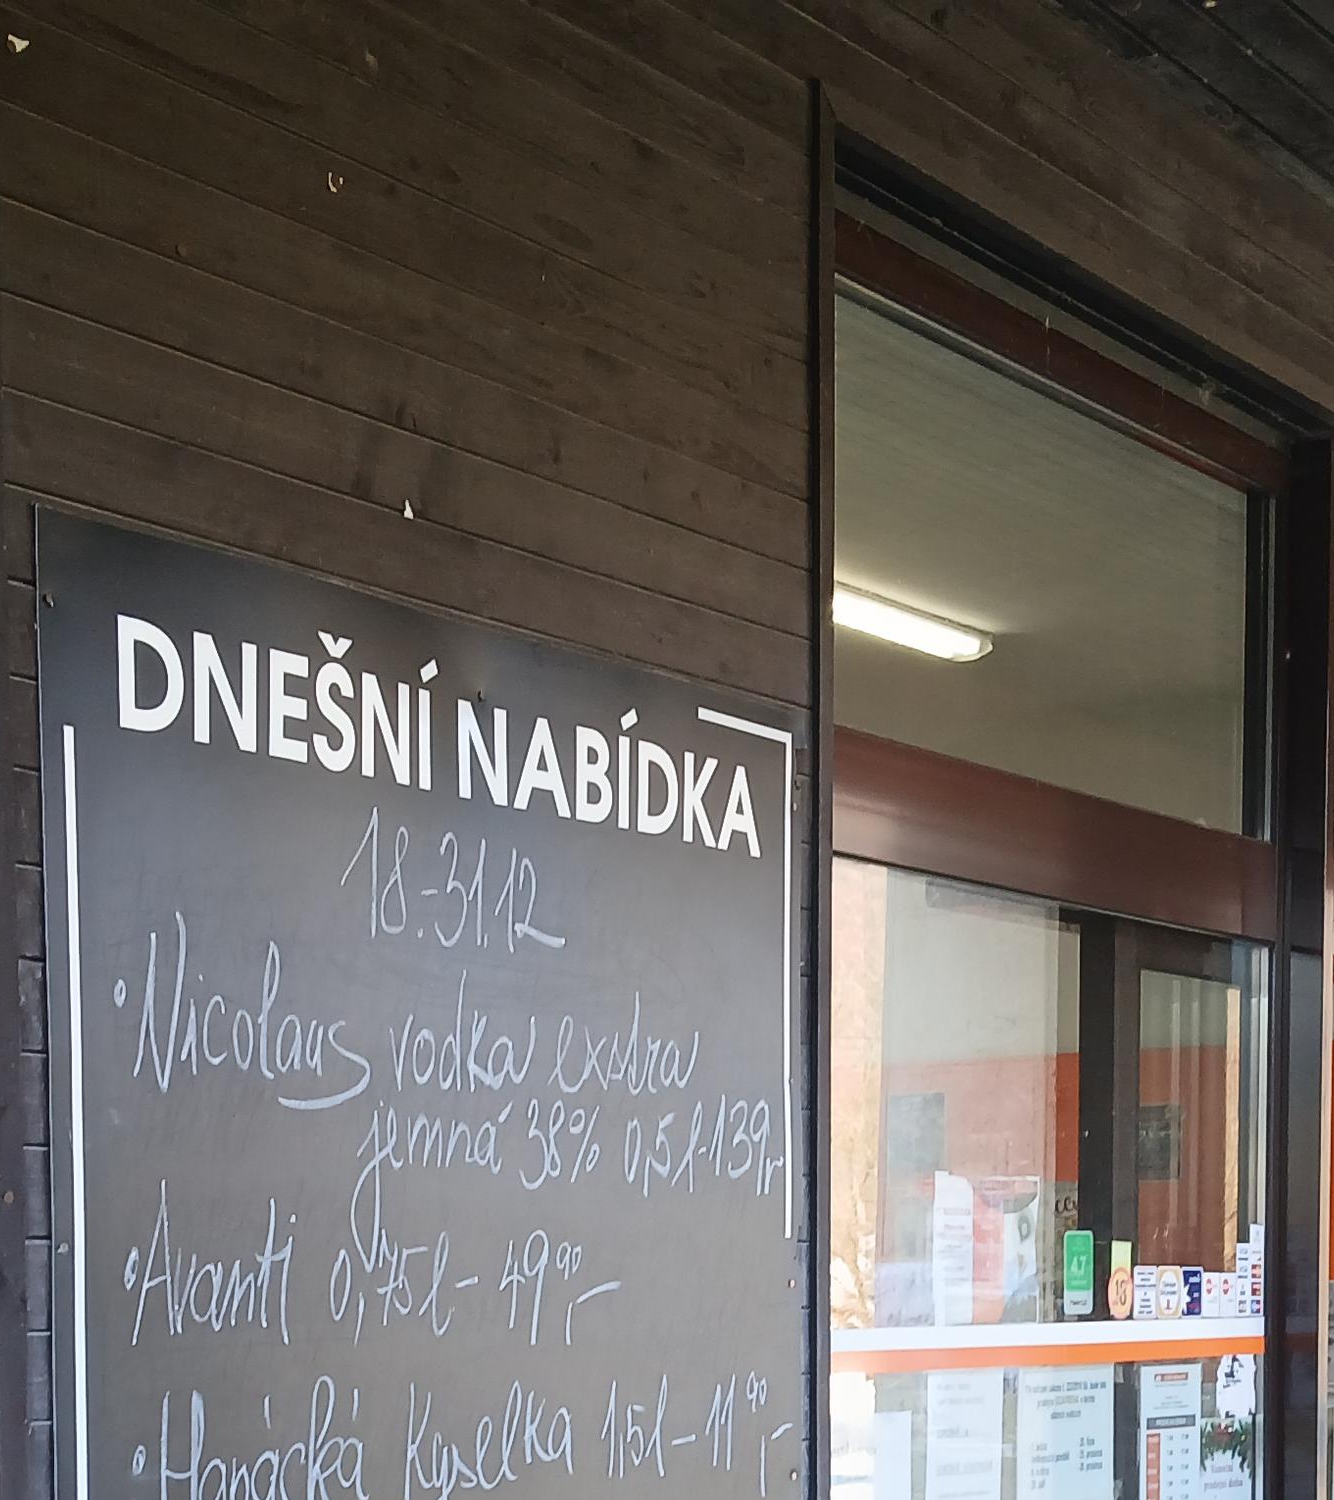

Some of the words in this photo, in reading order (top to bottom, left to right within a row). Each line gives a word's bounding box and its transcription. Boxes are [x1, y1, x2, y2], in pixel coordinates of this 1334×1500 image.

[116, 613, 439, 791] DNEŠNÍ
[457, 698, 762, 858] NABÍDKA
[133, 911, 371, 1110] Nicolaus
[389, 968, 536, 1093] vodka
[131, 1179, 297, 1346] Avanti
[350, 1099, 515, 1272] jemná
[519, 1097, 600, 1190] 38%
